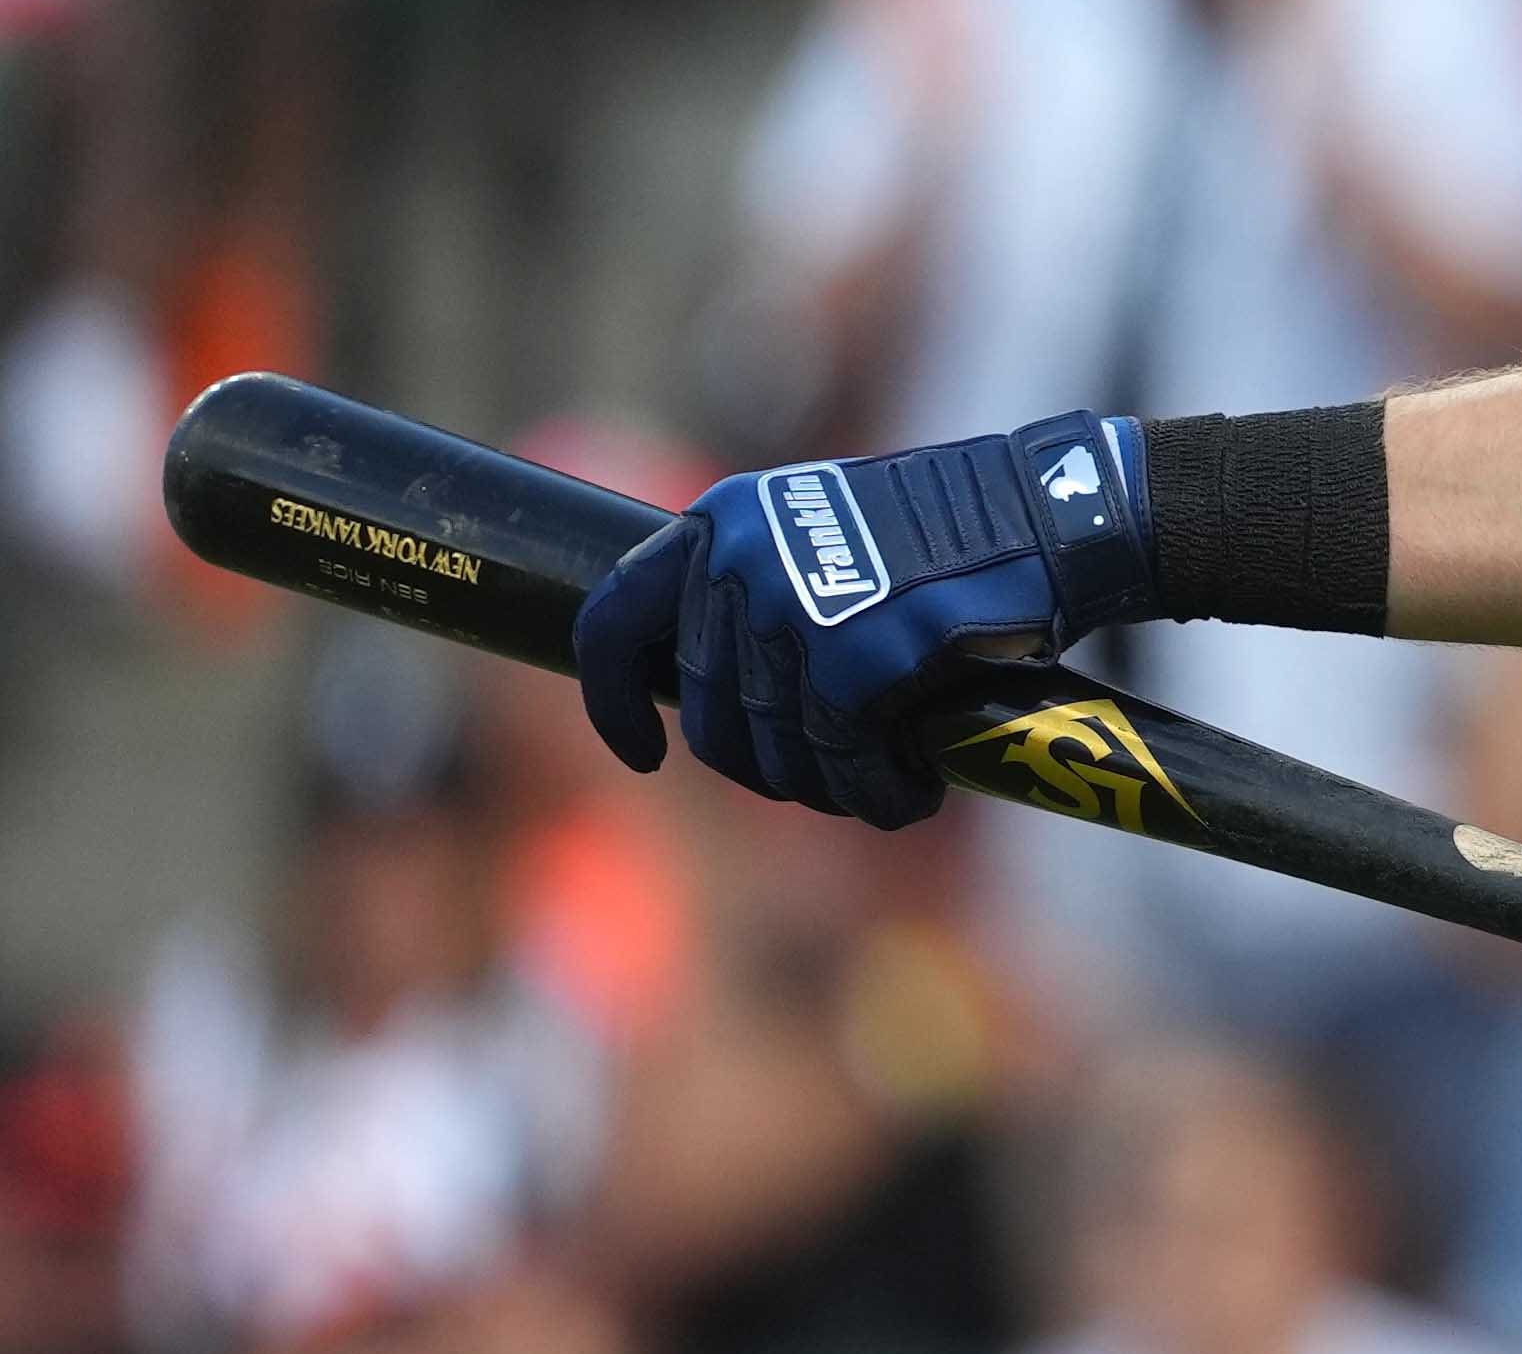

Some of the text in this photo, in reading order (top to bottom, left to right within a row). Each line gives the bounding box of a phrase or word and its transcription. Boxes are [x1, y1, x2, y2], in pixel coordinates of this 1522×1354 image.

[271, 497, 482, 585] NEW YORK YANKEES
